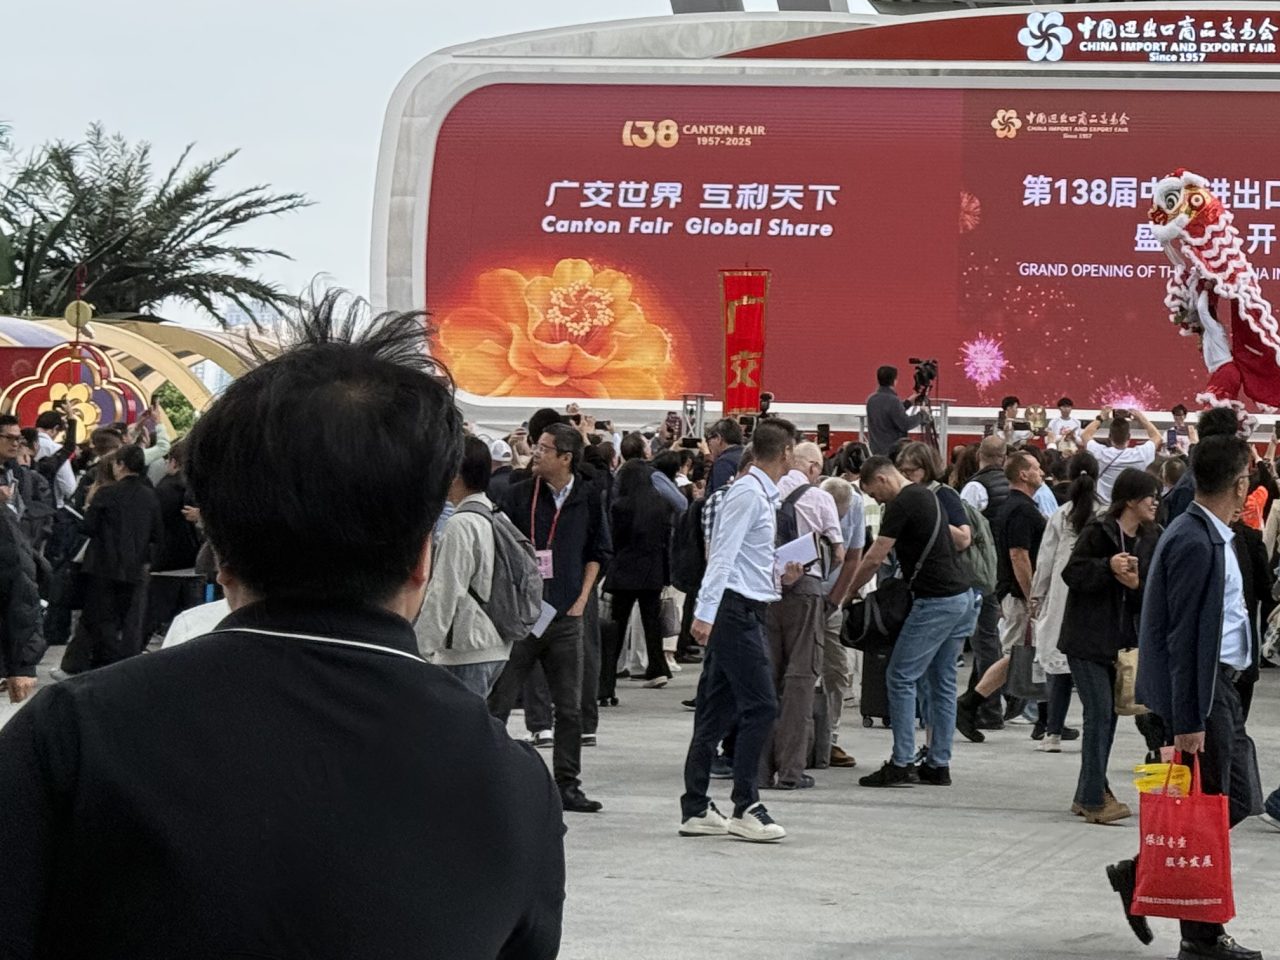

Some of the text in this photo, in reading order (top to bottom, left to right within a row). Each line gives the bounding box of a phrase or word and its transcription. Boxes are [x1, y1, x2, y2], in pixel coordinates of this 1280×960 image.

[1079, 41, 1276, 53] CHINA IMPORT AND EXPORT FAIR
[1149, 53, 1206, 62] Since 1957
[622, 119, 680, 148] 138
[682, 124, 766, 136] CANTON FAIR
[697, 137, 752, 147] 1957-2025
[545, 180, 841, 211] 广交世界 互利天下
[541, 216, 833, 237] Canton Fair Global Share
[1019, 263, 1068, 276] GRAND
[1071, 263, 1133, 277] OPENING
[1136, 265, 1155, 278] OF
[1159, 265, 1178, 279] TH
